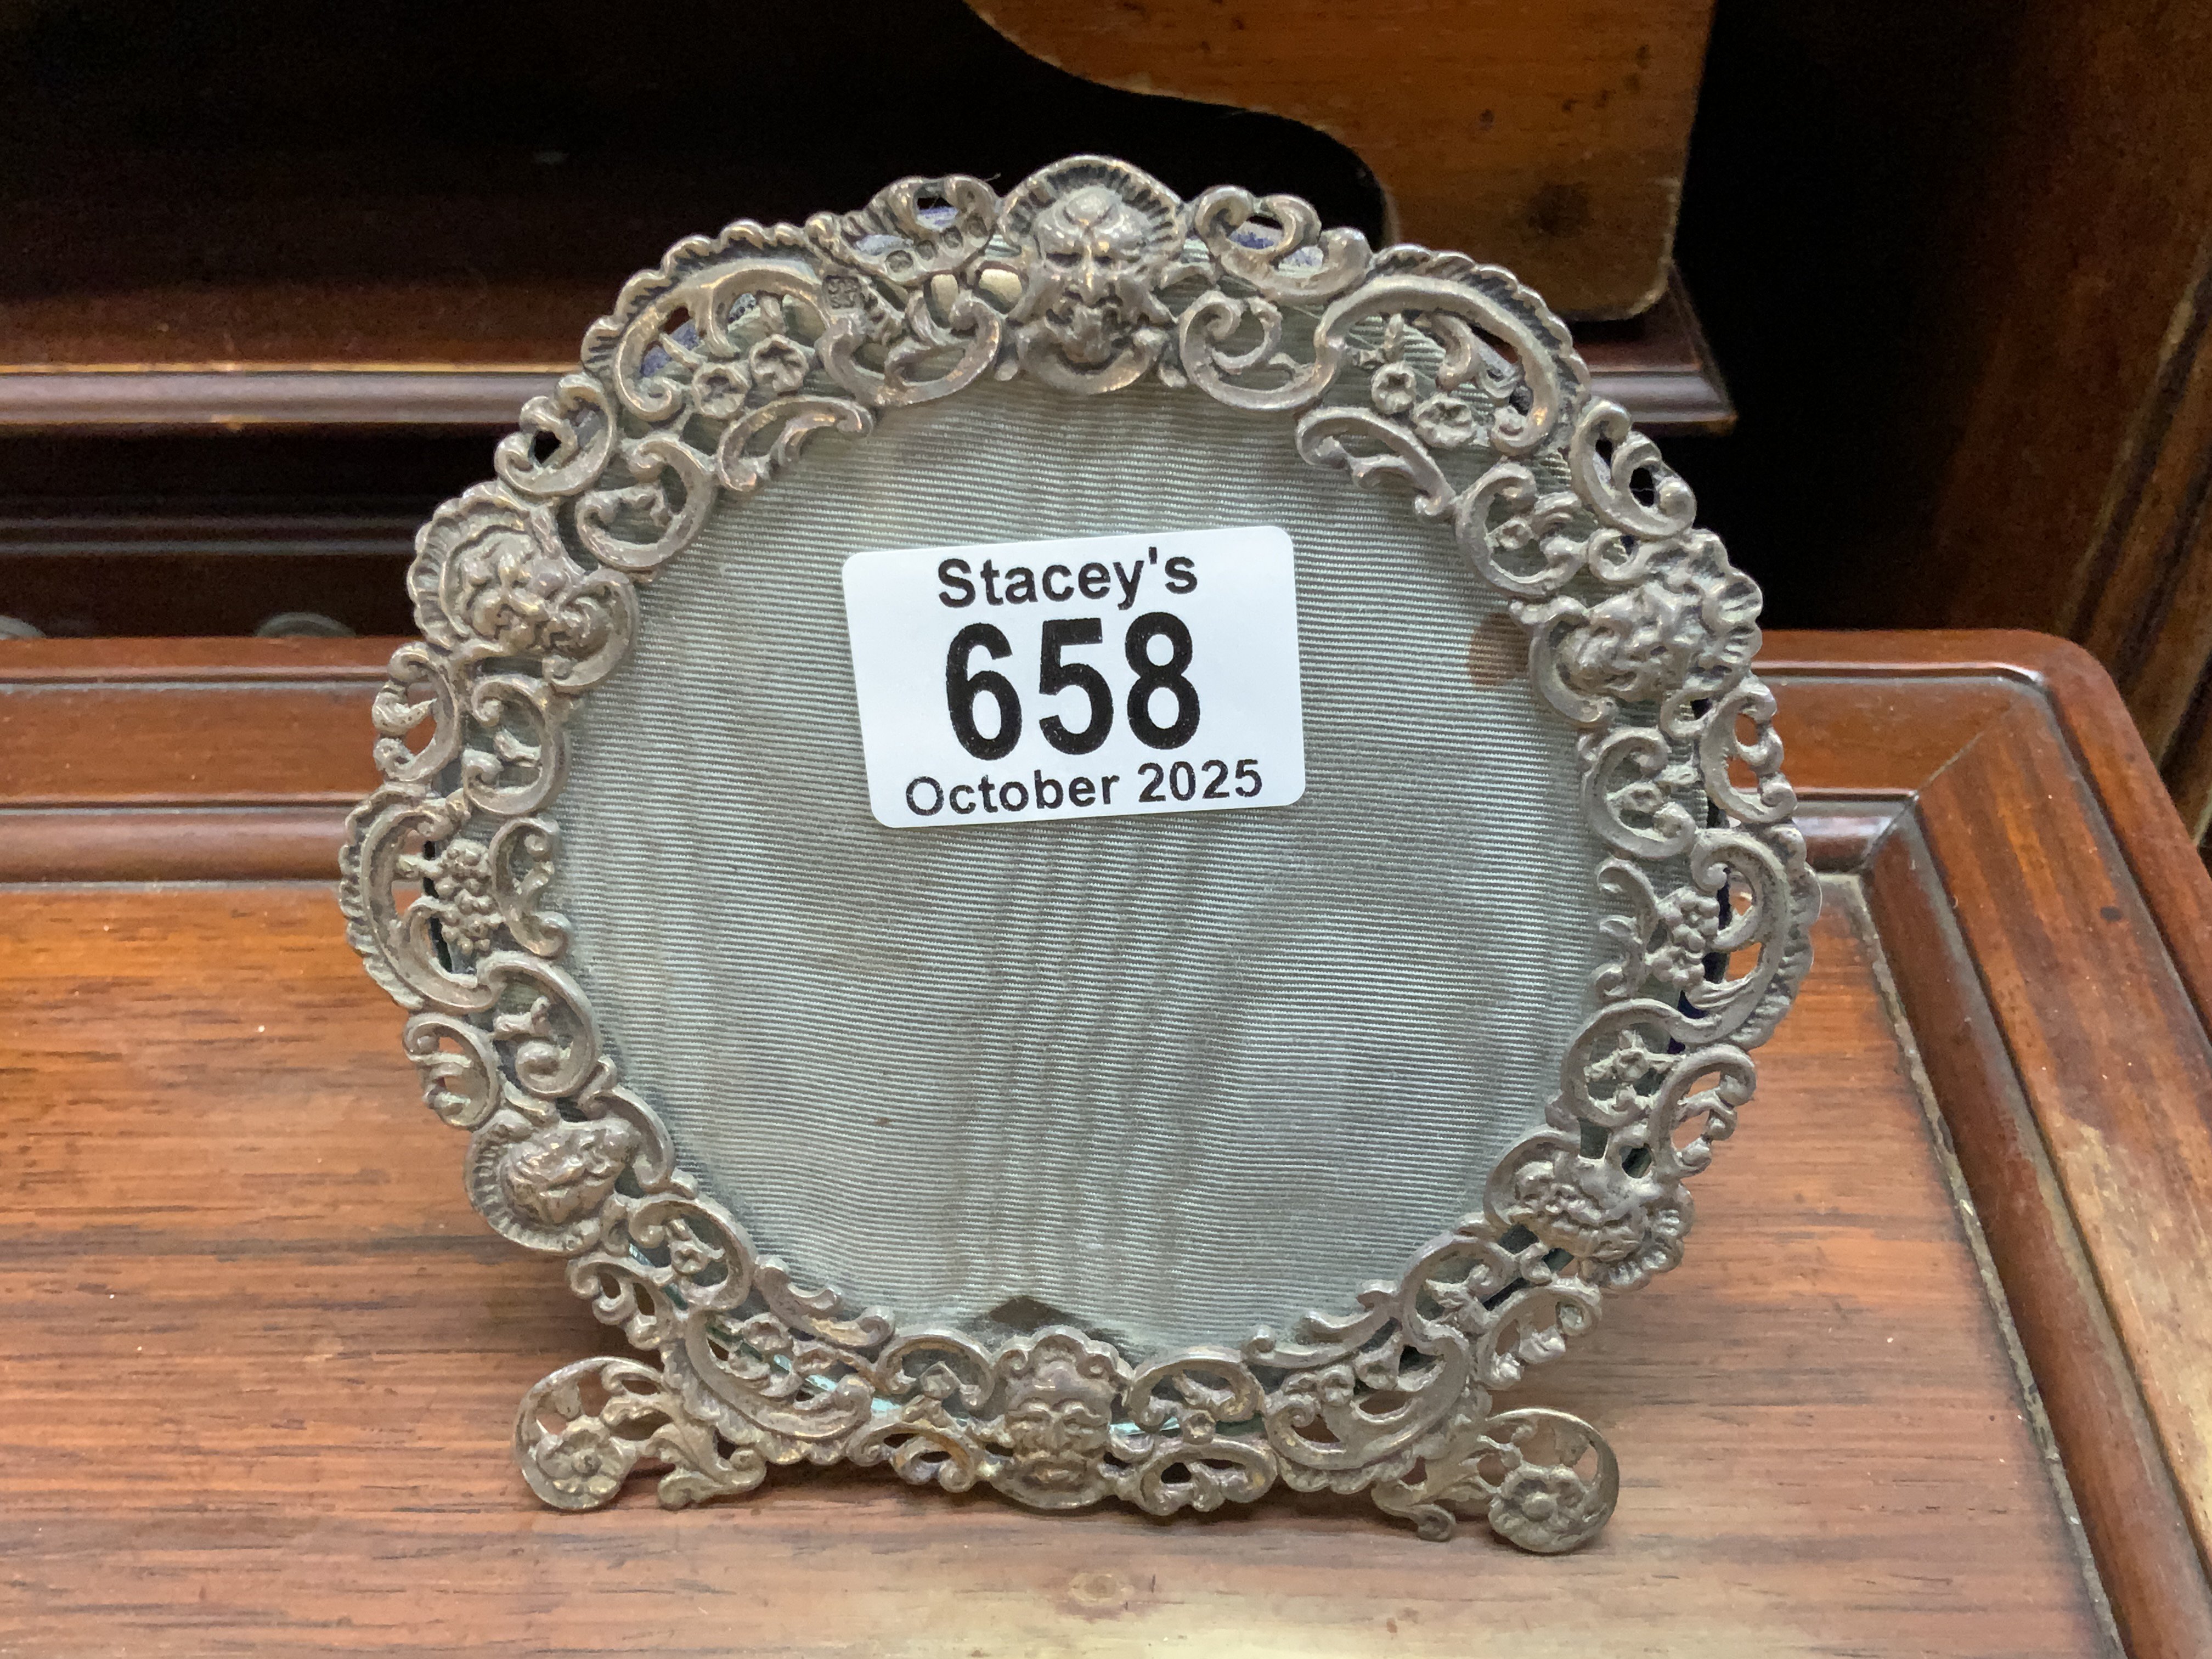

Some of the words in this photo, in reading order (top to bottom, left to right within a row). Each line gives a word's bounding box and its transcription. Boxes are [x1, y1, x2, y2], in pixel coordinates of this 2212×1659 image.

[938, 546, 1198, 611] Stacey's
[945, 612, 1200, 761] 658
[906, 769, 1120, 816] October
[1137, 759, 1262, 803] 2025
